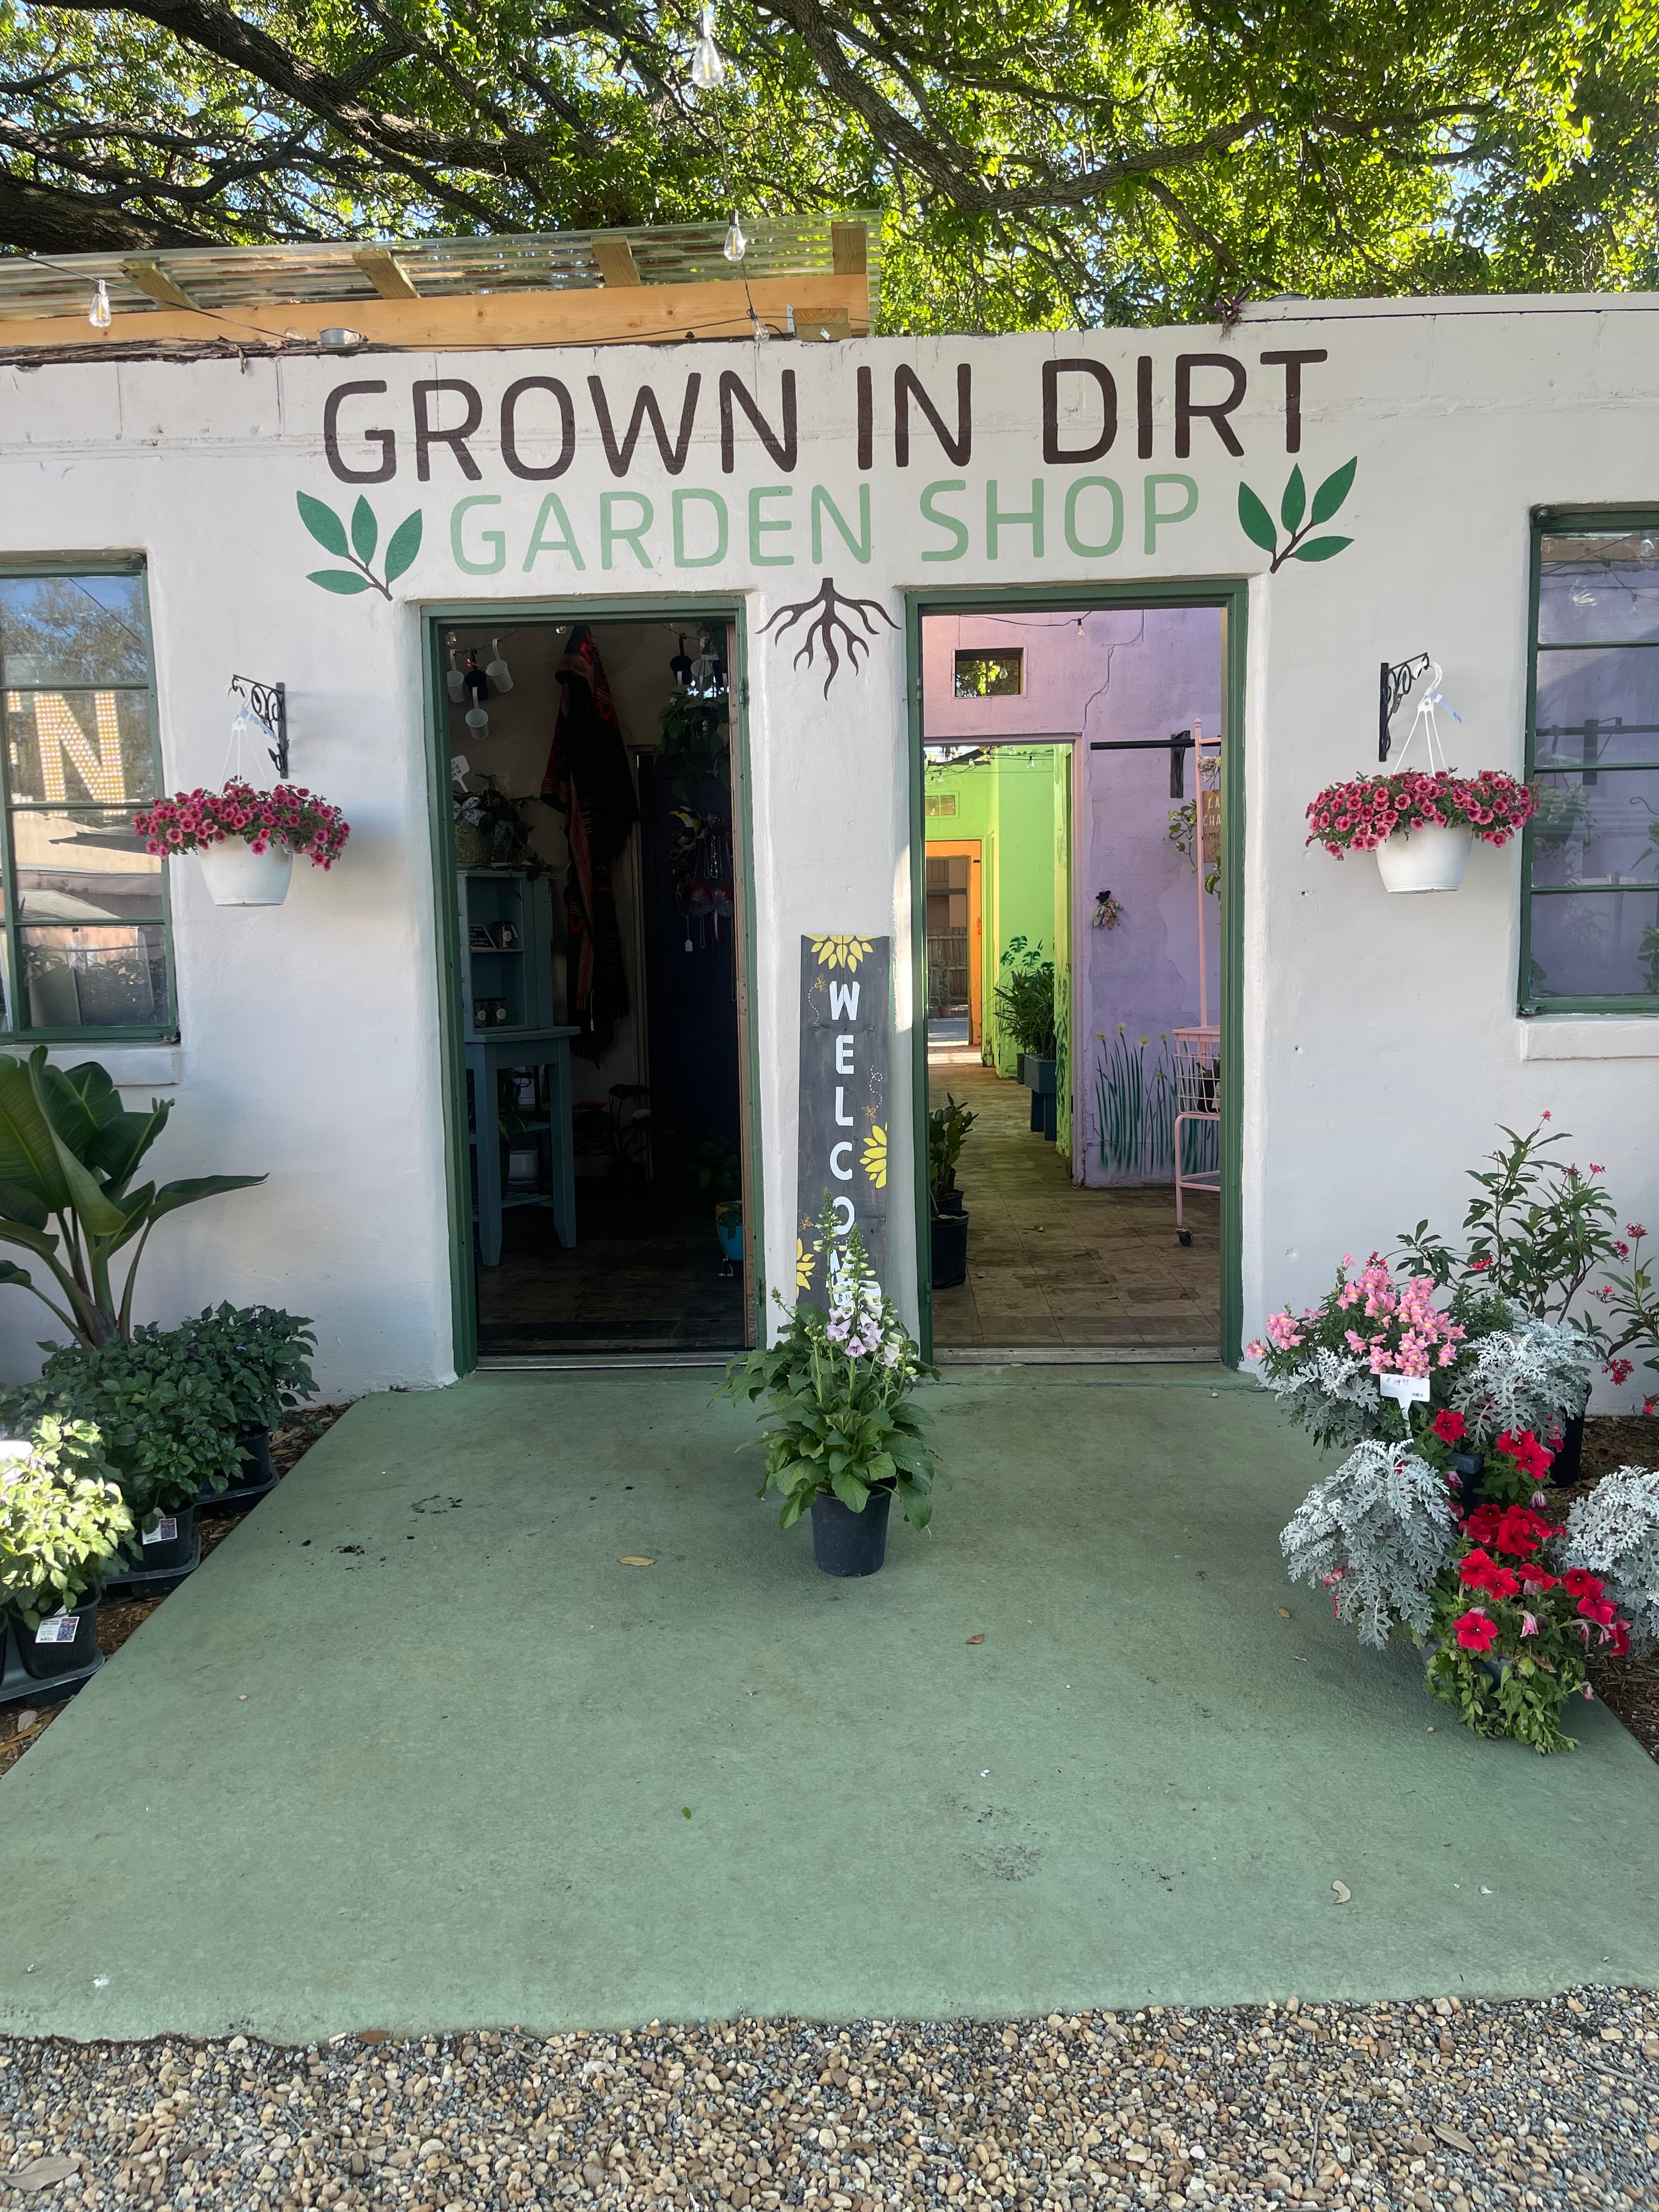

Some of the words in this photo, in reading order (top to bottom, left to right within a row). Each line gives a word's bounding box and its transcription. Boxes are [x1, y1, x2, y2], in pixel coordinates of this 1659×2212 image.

[324, 369, 798, 484] GROWN
[857, 363, 972, 470] IN
[1042, 349, 1328, 465] DIRT
[449, 484, 871, 575] GARDEN
[919, 473, 1199, 562] SHOP
